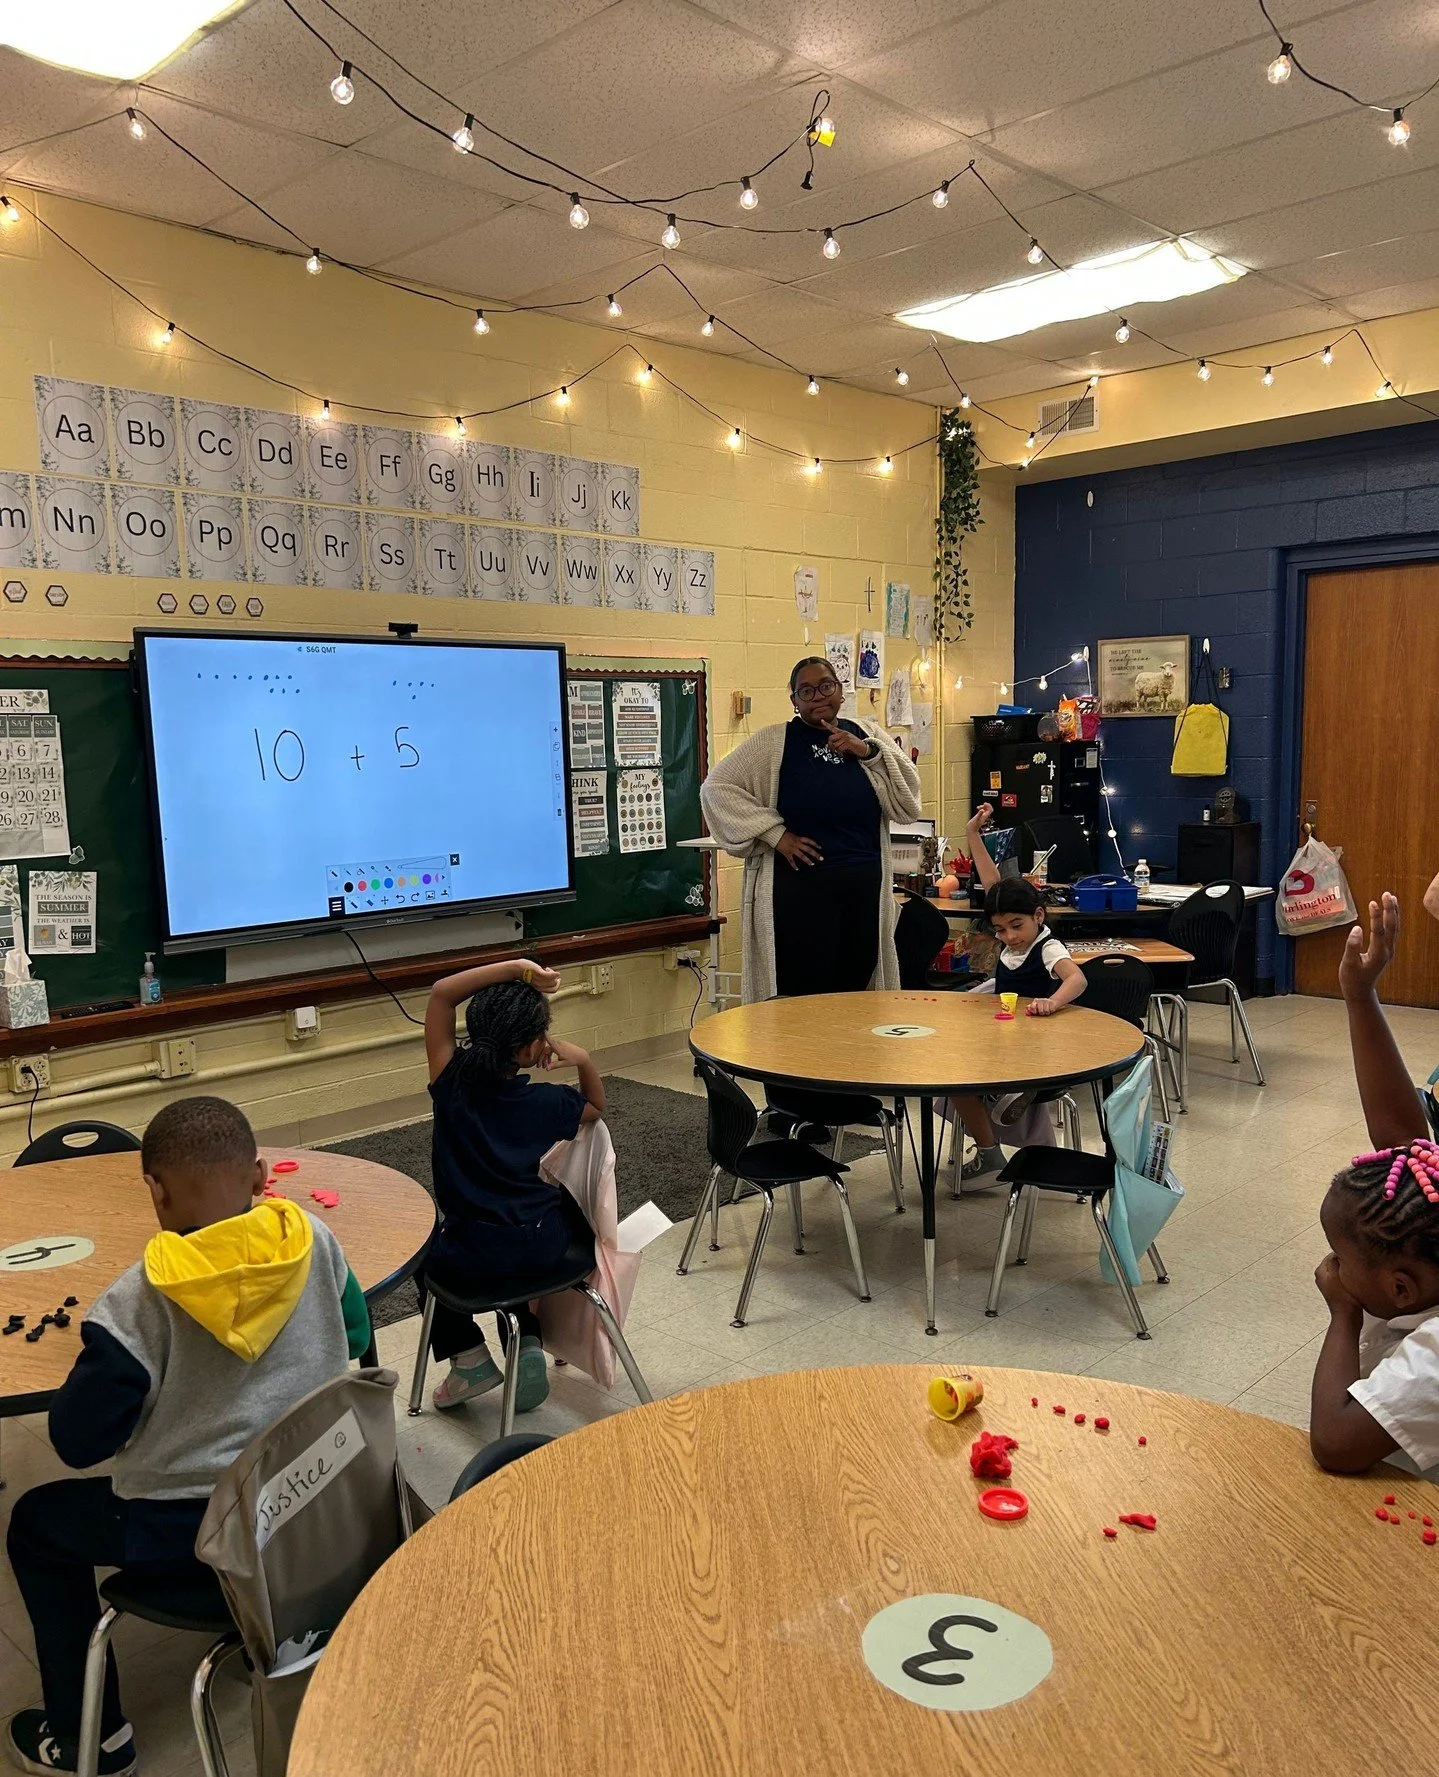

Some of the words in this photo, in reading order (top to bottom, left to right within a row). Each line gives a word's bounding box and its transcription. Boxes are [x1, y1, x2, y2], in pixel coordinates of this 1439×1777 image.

[56, 415, 94, 443] Aa
[128, 420, 164, 448] Bb
[199, 430, 232, 455] Cc
[259, 439, 292, 464] Dd
[321, 445, 347, 469] Ee
[380, 455, 401, 477] Ff
[429, 464, 455, 492] Gg
[478, 466, 504, 488] Hh
[529, 471, 539, 497] Ii
[572, 485, 586, 509] Jj
[612, 490, 631, 510] Kk
[54, 507, 95, 534] Nn
[126, 512, 165, 537] Oo
[200, 520, 232, 550] Pp
[261, 526, 296, 556] Qq
[325, 535, 349, 557] Rr
[381, 544, 404, 565] Ss
[434, 549, 456, 570] Tt
[481, 551, 505, 572] Uu
[526, 555, 549, 575] Vv
[567, 559, 597, 579] Ww
[616, 565, 634, 583] Xx
[654, 567, 671, 591] Yy
[691, 569, 706, 587] Zz
[17, 744, 26, 757] 6
[43, 744, 50, 757] 7
[254, 728, 305, 781] 10
[395, 726, 420, 768] 5
[18, 767, 31, 780] 13
[42, 767, 54, 779] 14
[17, 790, 34, 803] 20
[42, 789, 56, 802] 21
[20, 813, 35, 826] 27
[44, 811, 61, 824] 28
[40, 903, 86, 912] SUMMER
[58, 929, 68, 940] &
[72, 932, 90, 940] HOT
[256, 1458, 333, 1531] Justice
